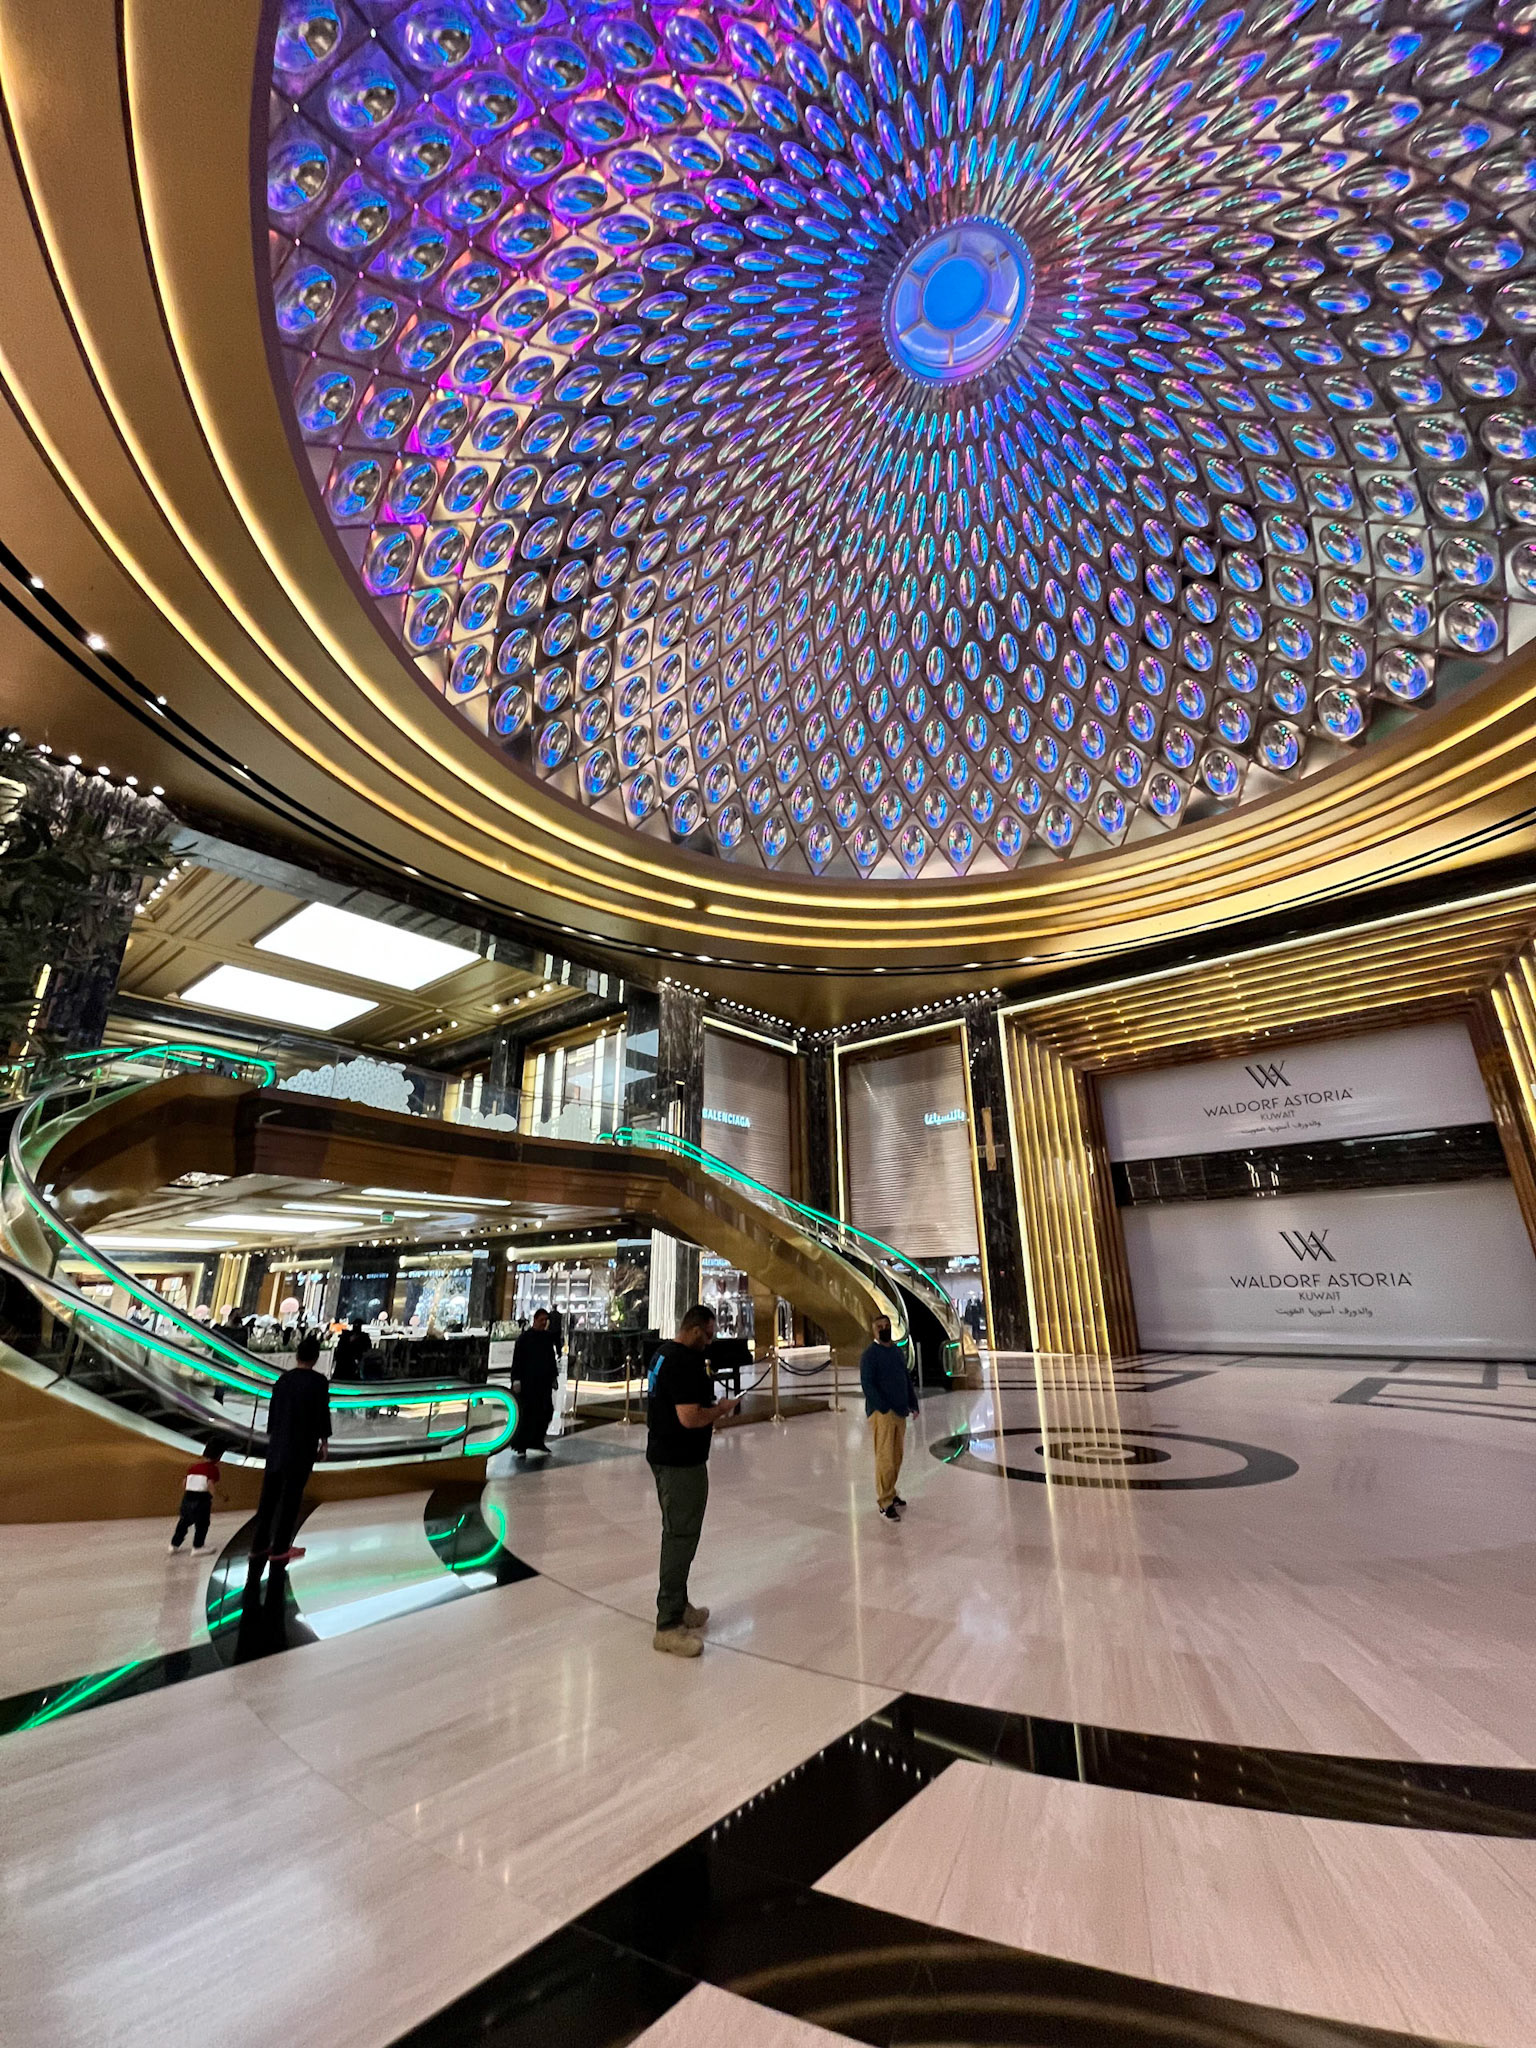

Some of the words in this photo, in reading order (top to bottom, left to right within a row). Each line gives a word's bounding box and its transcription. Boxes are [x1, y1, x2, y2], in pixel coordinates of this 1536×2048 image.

[1203, 1097, 1279, 1118] WALDORF
[1284, 1088, 1353, 1108] ASTORIA
[702, 1107, 750, 1128] BALENCIAGA
[1260, 1109, 1296, 1121] KUWAIT
[1230, 1273, 1321, 1289] WALDORF
[1327, 1271, 1413, 1288] ASTORIA
[1299, 1291, 1341, 1301] KUWAIT
